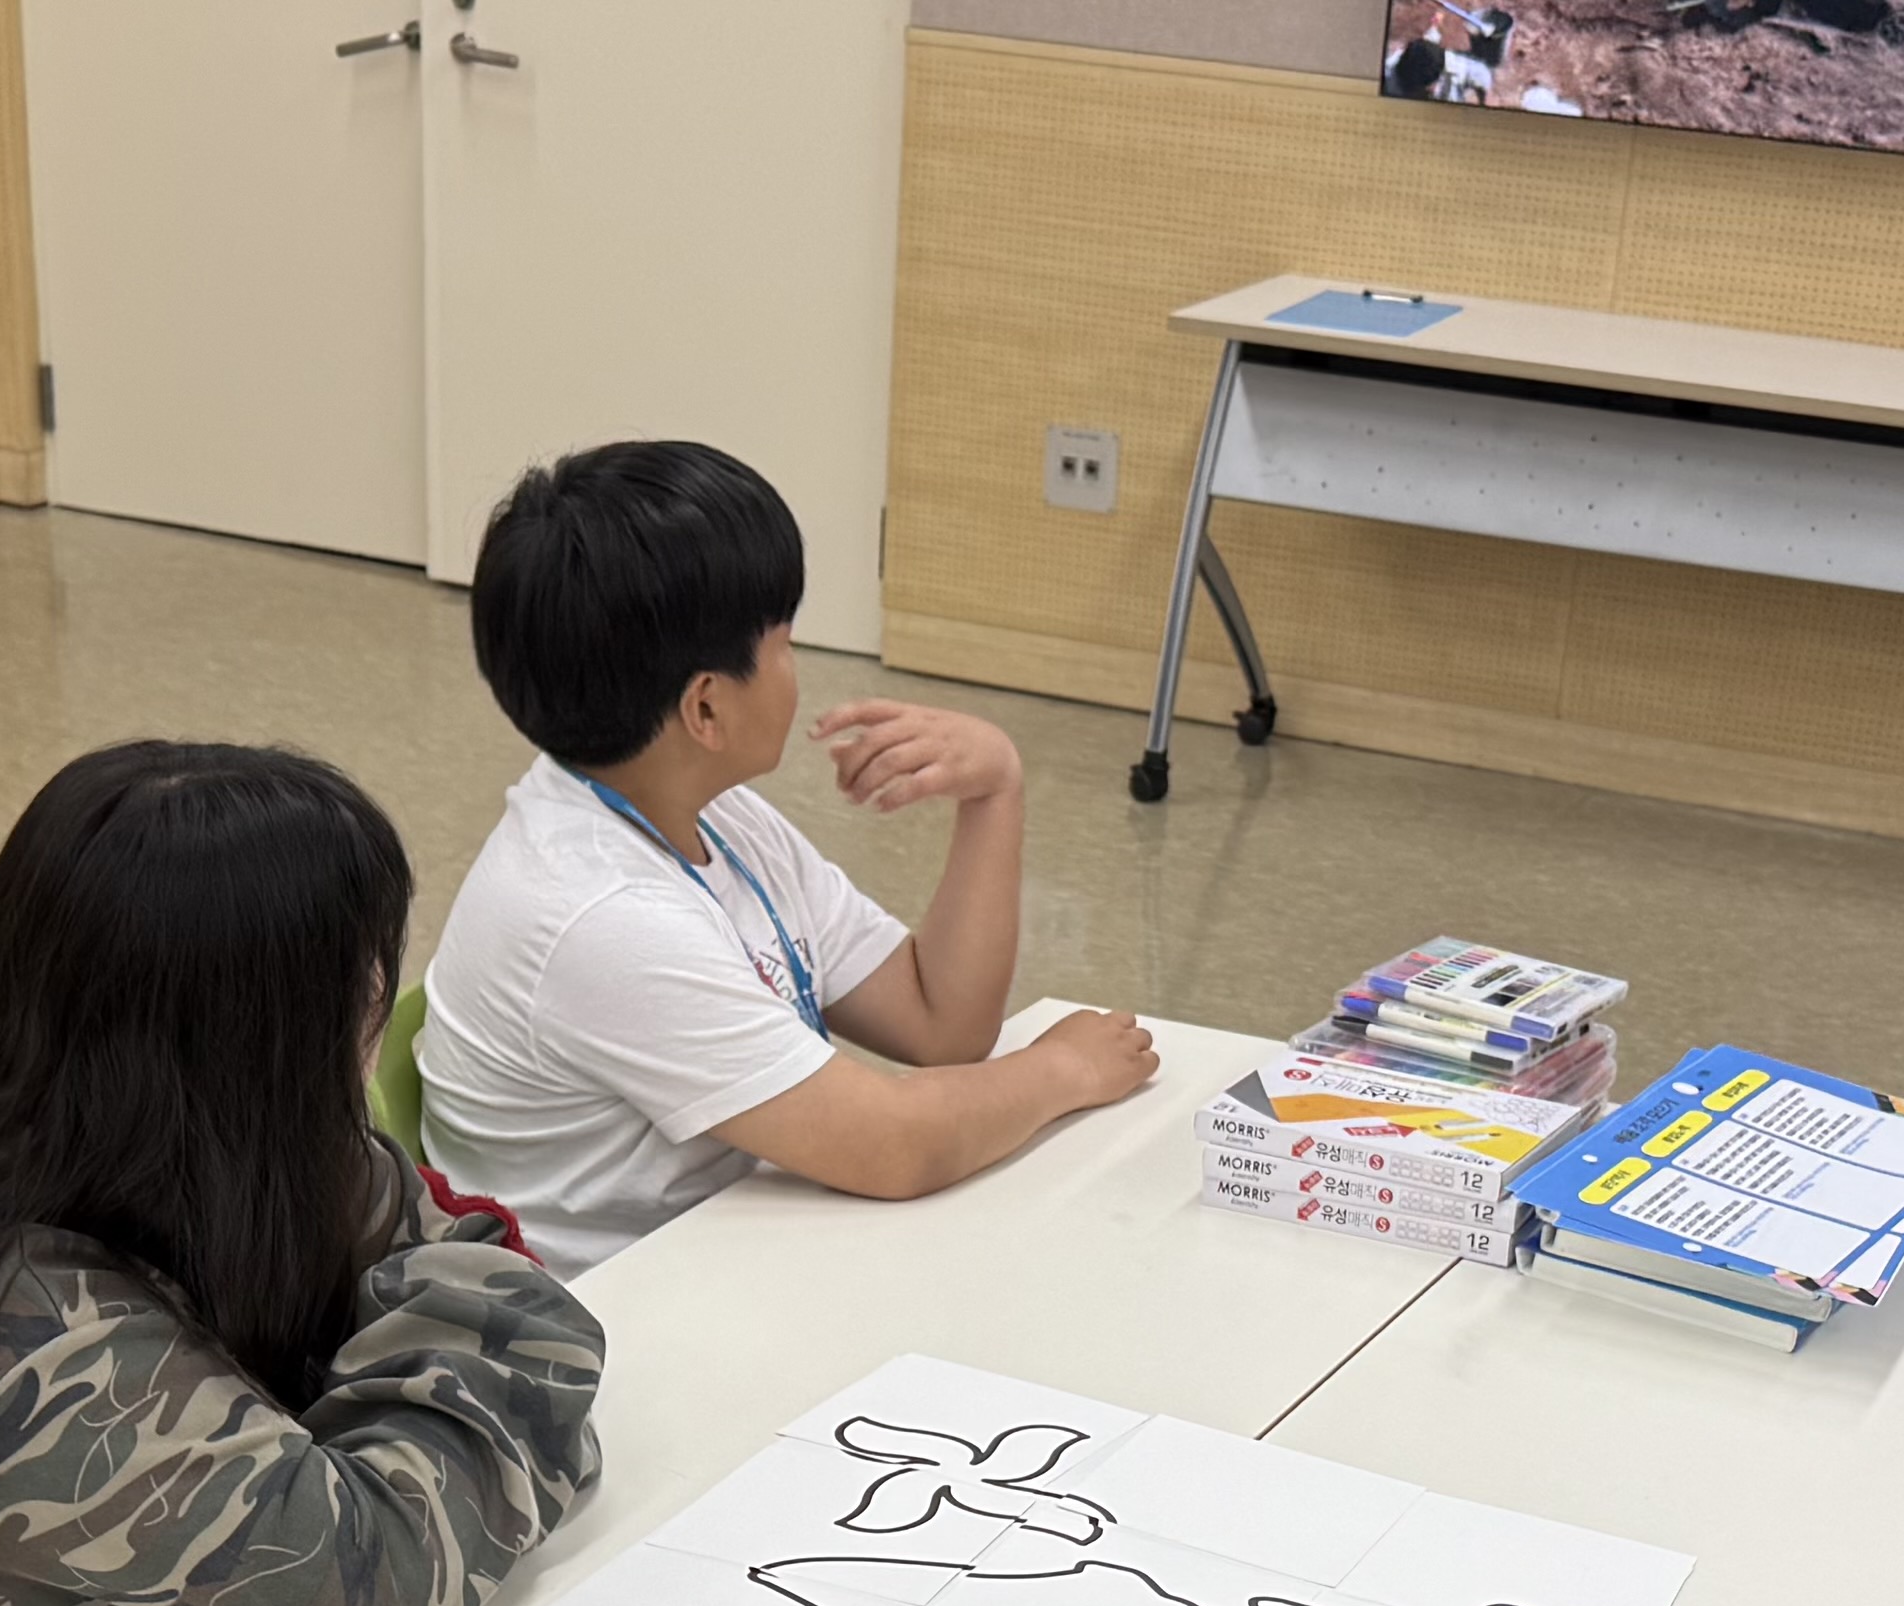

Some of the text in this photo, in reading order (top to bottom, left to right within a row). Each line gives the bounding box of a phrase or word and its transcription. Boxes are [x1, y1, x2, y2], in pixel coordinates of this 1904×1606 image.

[1212, 1118, 1266, 1140] MORRIS
[1218, 1154, 1273, 1176] MORRIS
[1315, 1141, 1368, 1168] 유성매직
[1461, 1171, 1483, 1189] 12
[1217, 1181, 1271, 1203] MORRIS
[1323, 1176, 1378, 1201] 유성매직
[1472, 1203, 1494, 1221] 12
[1321, 1204, 1374, 1230] 유성매직
[1467, 1233, 1490, 1251] 12
